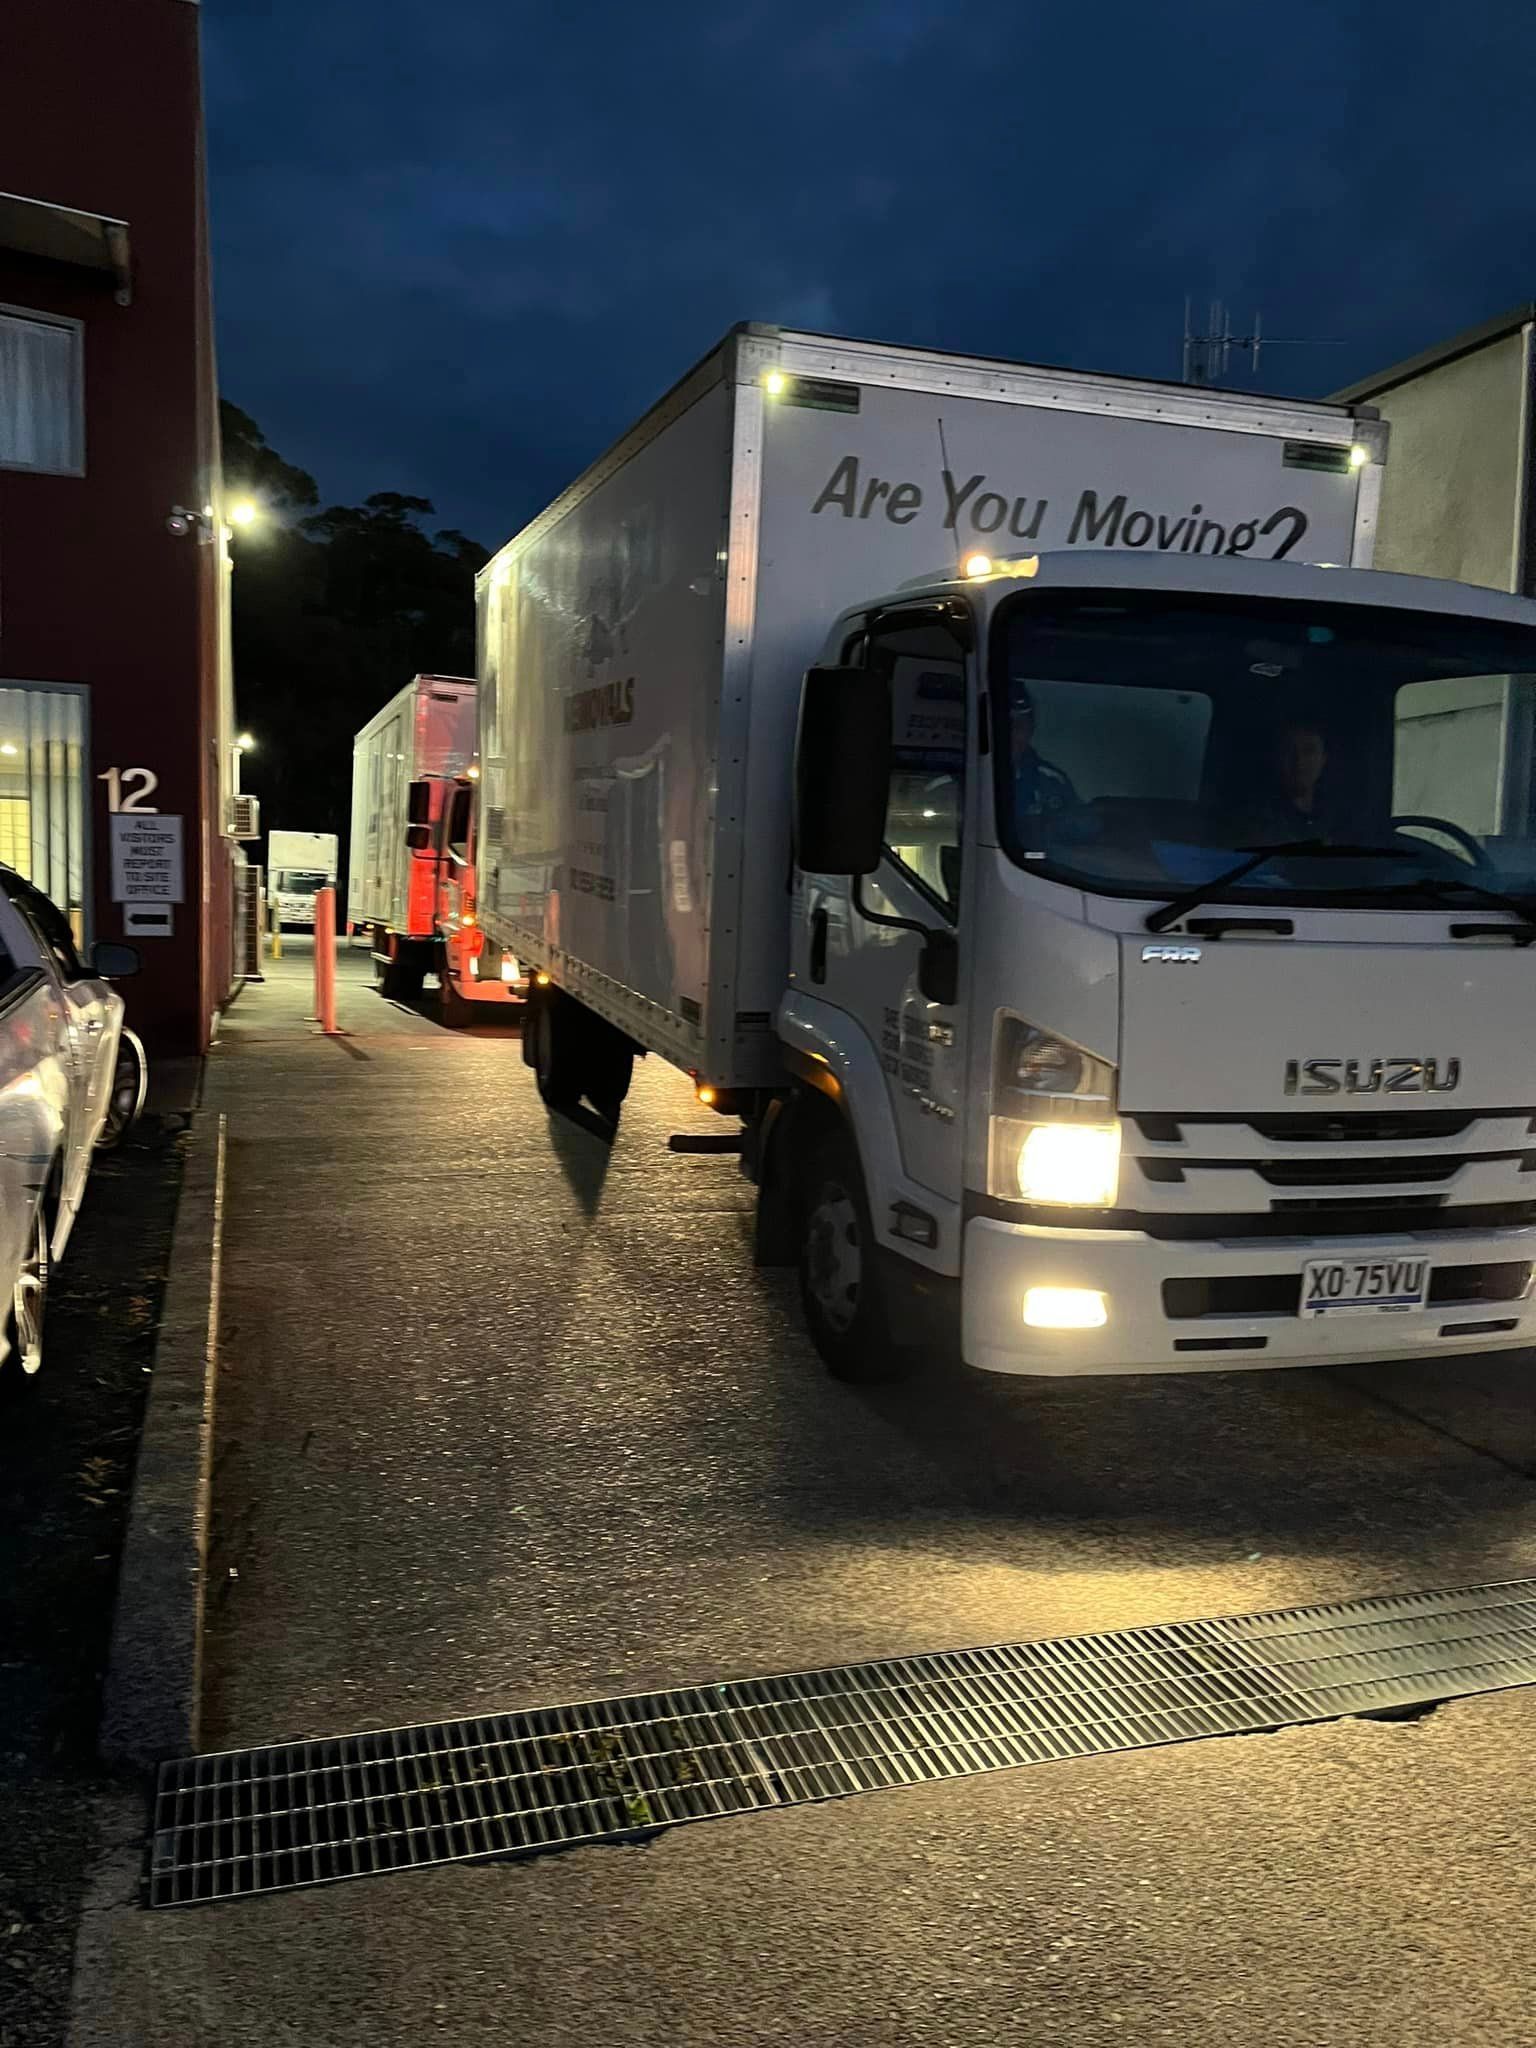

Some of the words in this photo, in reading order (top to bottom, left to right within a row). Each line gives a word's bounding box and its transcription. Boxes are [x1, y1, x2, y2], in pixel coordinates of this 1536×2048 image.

[812, 455, 922, 526] Are
[941, 469, 1047, 540] You
[97, 767, 159, 814] 12
[134, 821, 160, 831] ALL
[130, 846, 164, 857] MUST
[123, 858, 172, 869] REPORT
[144, 871, 171, 883] SITE
[126, 884, 171, 896] OFFICE
[1142, 945, 1201, 963] FRR
[1284, 1057, 1460, 1096] ISUZU
